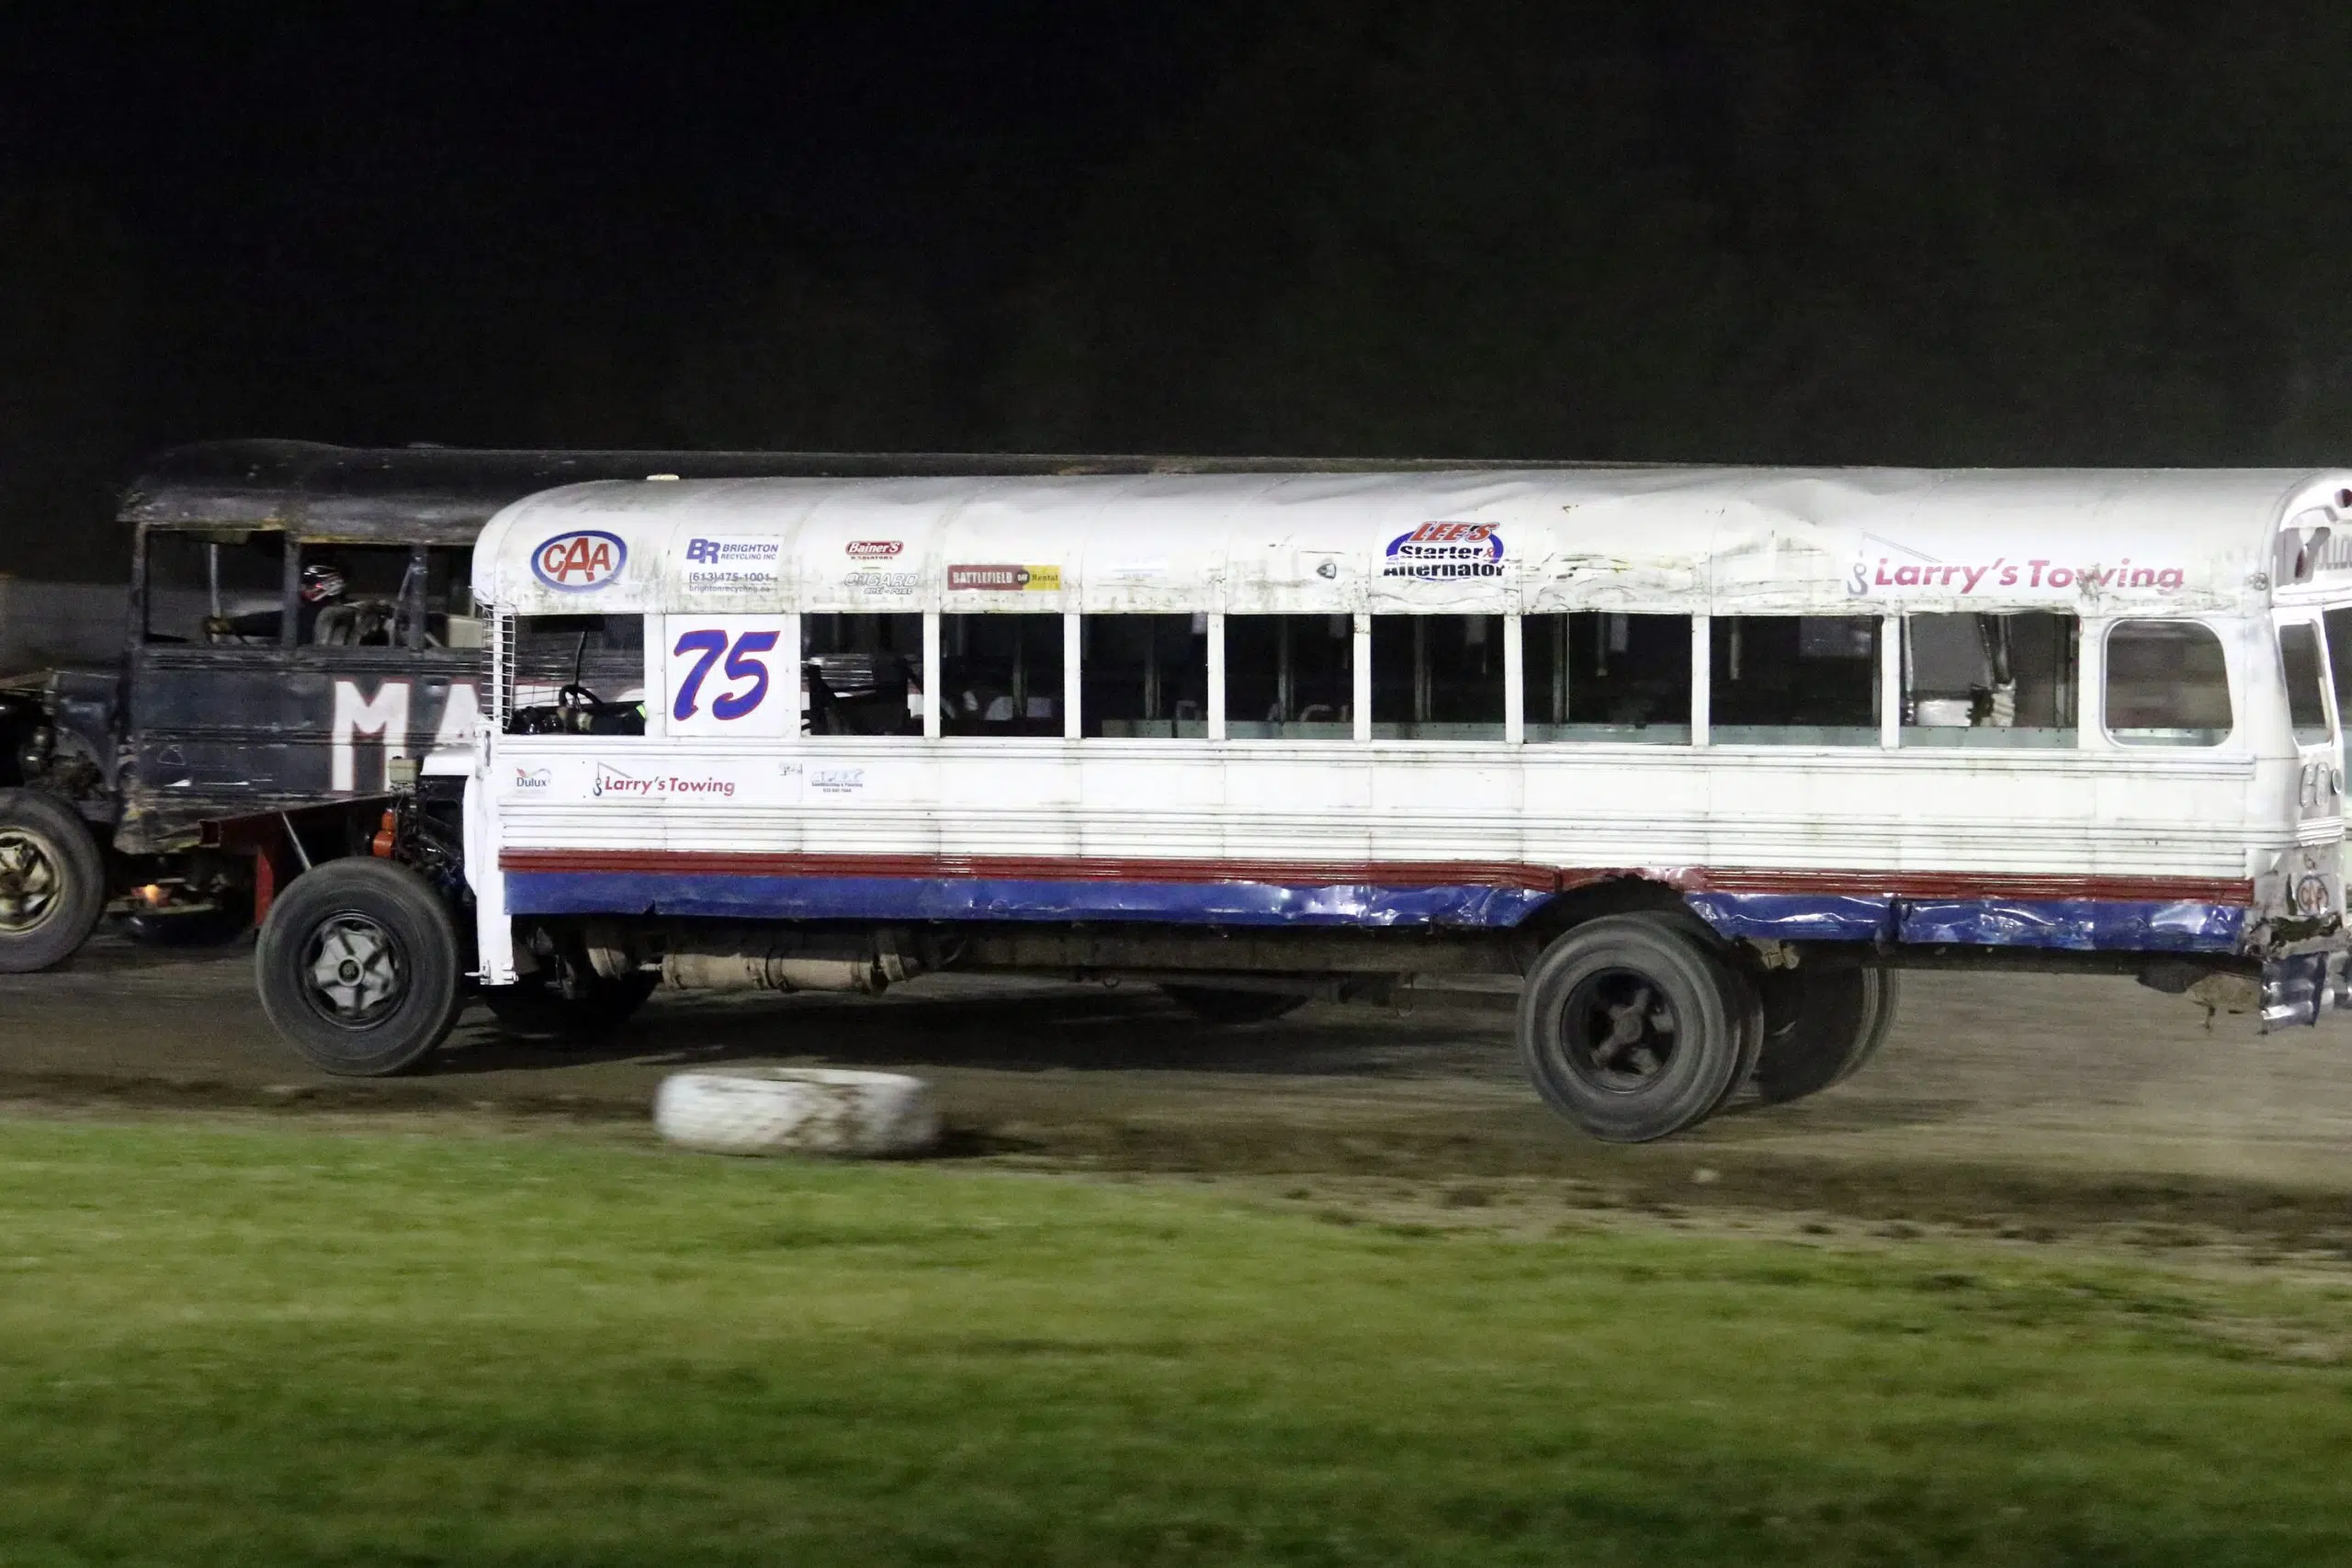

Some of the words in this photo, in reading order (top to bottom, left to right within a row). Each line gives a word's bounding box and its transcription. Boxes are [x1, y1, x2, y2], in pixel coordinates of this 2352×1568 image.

[1407, 521, 1499, 543] LEE'S
[686, 538, 721, 564] BR
[722, 544, 779, 552] BRIGHTON
[1400, 546, 1483, 558] Starter
[544, 537, 612, 581] CAA
[953, 571, 1012, 583] BATTLEFIELD
[1875, 558, 2018, 594] Larry's
[2028, 558, 2186, 597] Towing
[673, 629, 781, 721] 75
[516, 777, 547, 787] Dulux
[605, 776, 665, 795] Larry's
[669, 777, 735, 796] Towing
